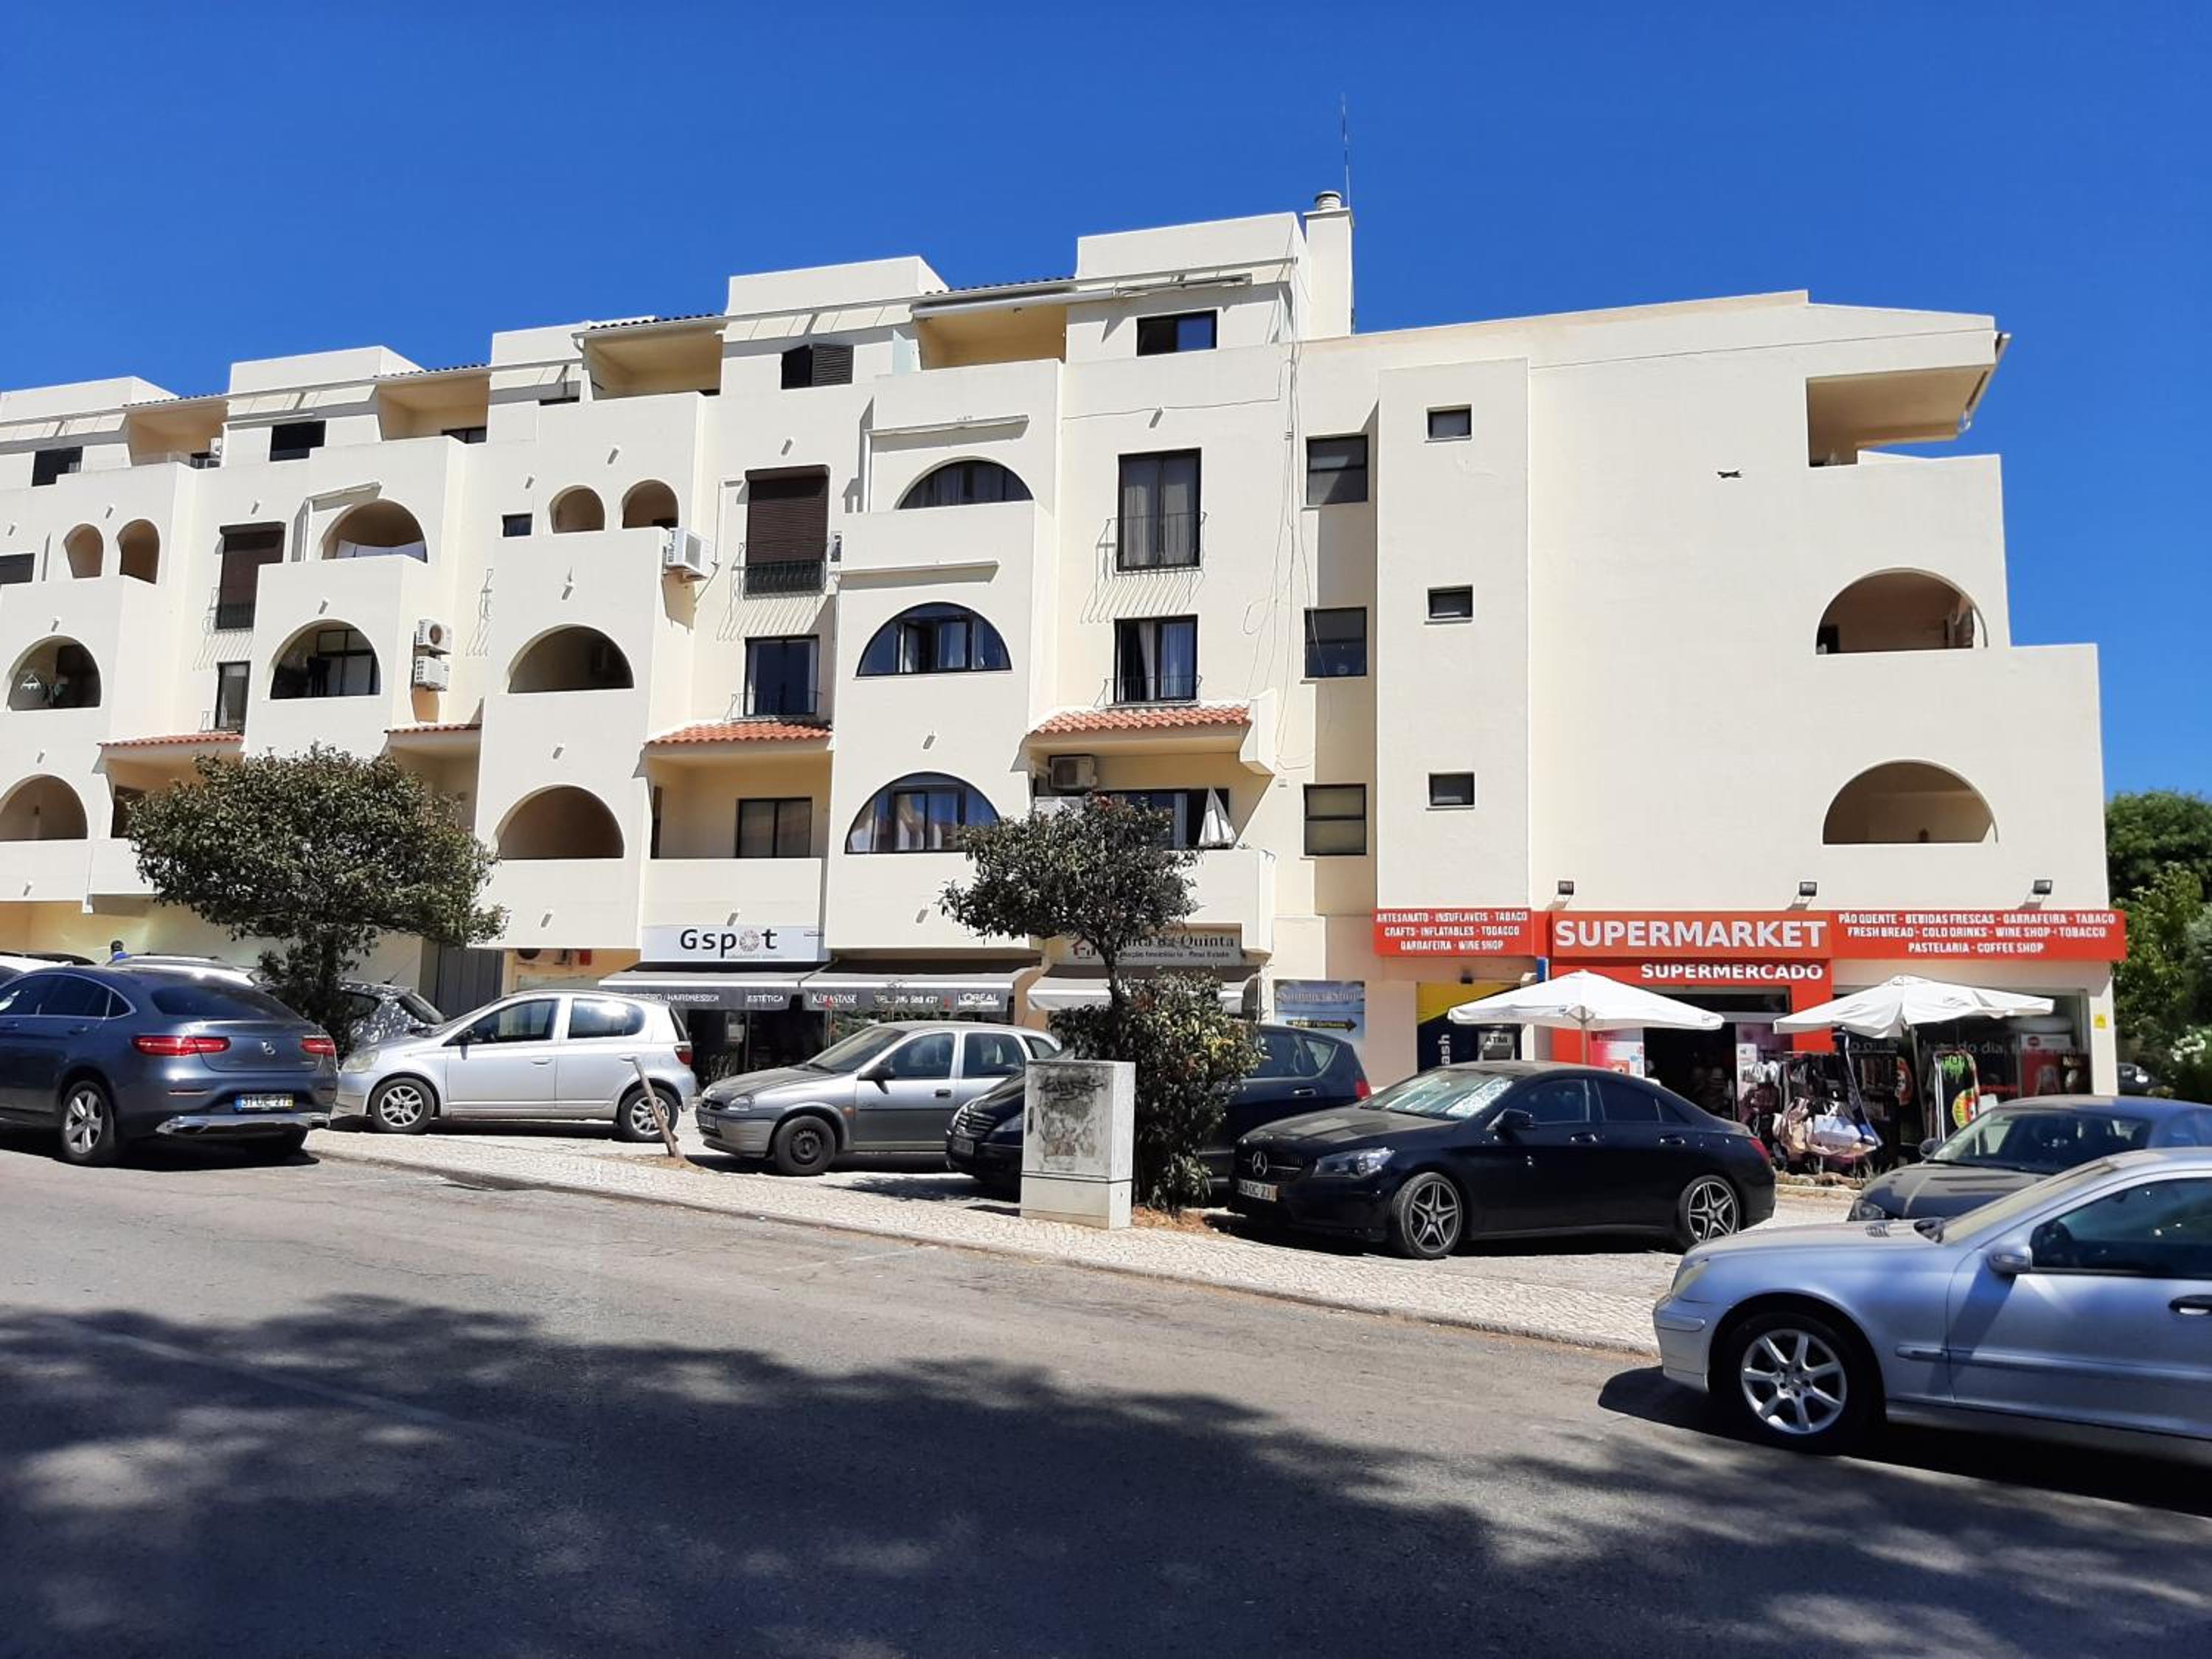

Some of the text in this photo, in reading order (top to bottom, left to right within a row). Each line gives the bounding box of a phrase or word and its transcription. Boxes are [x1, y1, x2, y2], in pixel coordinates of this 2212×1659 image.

[1377, 913, 1429, 922] ARTESANATO
[1495, 911, 1528, 921] TABACO
[1838, 912, 1857, 924] PÃO
[1858, 914, 1897, 924] QUENTE
[1905, 914, 1948, 924] BEBIDAS
[1950, 914, 1994, 924] FRESCAS
[2003, 914, 2067, 924] GARRAFEIRA
[2075, 913, 2115, 924] TABACO
[1385, 927, 1416, 936] CRAFTS
[1421, 926, 1475, 936] INFLATABLES
[1481, 925, 1520, 936] TOBACCO
[1555, 920, 1827, 947] SUPERMARKET
[1847, 927, 1879, 937] FRESH
[1881, 927, 1914, 937] BREAD
[1922, 927, 1947, 937] COLD
[1949, 927, 1987, 937] DRINKS
[1995, 927, 2022, 937] WINE
[2024, 927, 2051, 937] SHOP
[2059, 927, 2107, 937] TOBACCO
[1180, 933, 1234, 948] Quinta
[1400, 941, 1452, 950] GARRAFEIRA
[1458, 940, 1480, 950] WINE
[1481, 940, 1504, 950] SHOP
[1908, 942, 1969, 953] PASTELARIA
[1977, 943, 2014, 953] COFFEE
[2017, 942, 2044, 953] SHOP
[1641, 964, 1823, 979] SUPERMERCADO
[1485, 1035, 1509, 1043] ATM
[1438, 1034, 1450, 1065] ash
